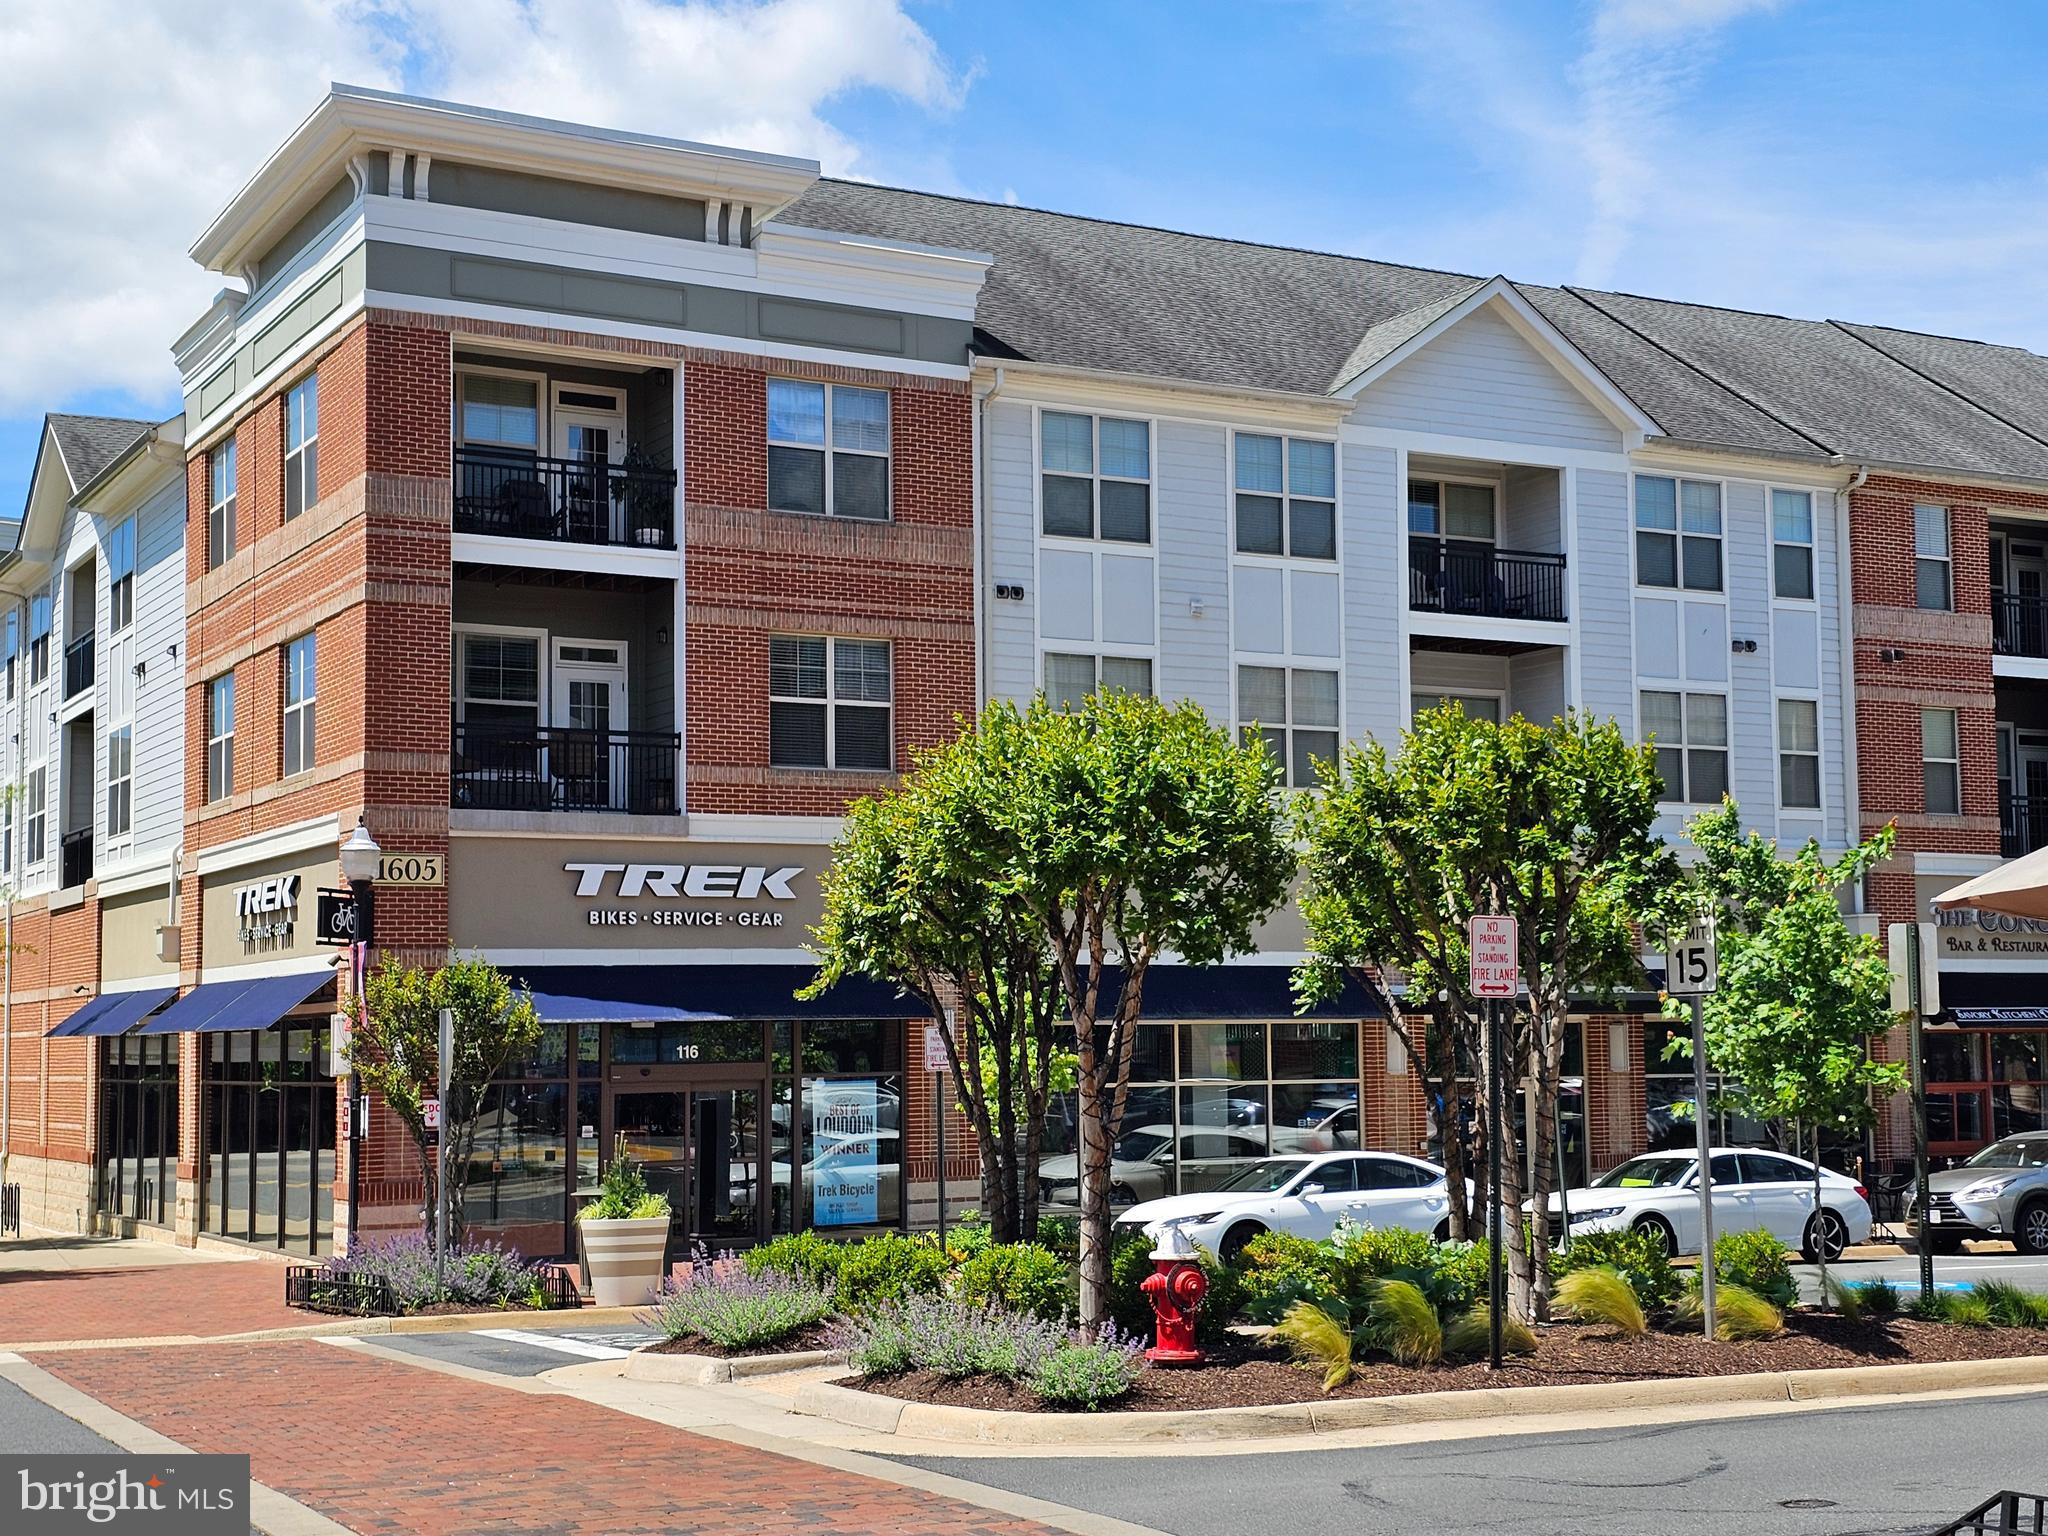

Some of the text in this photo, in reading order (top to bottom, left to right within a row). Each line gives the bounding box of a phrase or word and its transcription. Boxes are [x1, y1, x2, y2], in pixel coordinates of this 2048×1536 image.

[376, 858, 437, 881] 1605
[564, 863, 806, 899] TREK
[232, 875, 300, 917] TREK
[589, 911, 784, 927] BIKES SERVICE GEAR
[1976, 909, 2048, 933] CON
[1486, 922, 1499, 932] NO
[1480, 935, 1507, 944] PARKING
[1947, 937, 1974, 952] BAR
[1977, 938, 1987, 952] &
[1478, 953, 1509, 963] STANDING
[1675, 948, 1708, 984] 15
[1474, 968, 1515, 981] FIRE LANE
[1955, 1009, 1992, 1019] SAVORY
[1991, 1009, 2036, 1019] KITCHEN
[676, 1045, 699, 1059] 116
[829, 1103, 861, 1116] BEST OF
[816, 1115, 874, 1136] LOUDOUN
[821, 1143, 870, 1155] WINNER
[817, 1182, 875, 1198] Trek Bicycle
